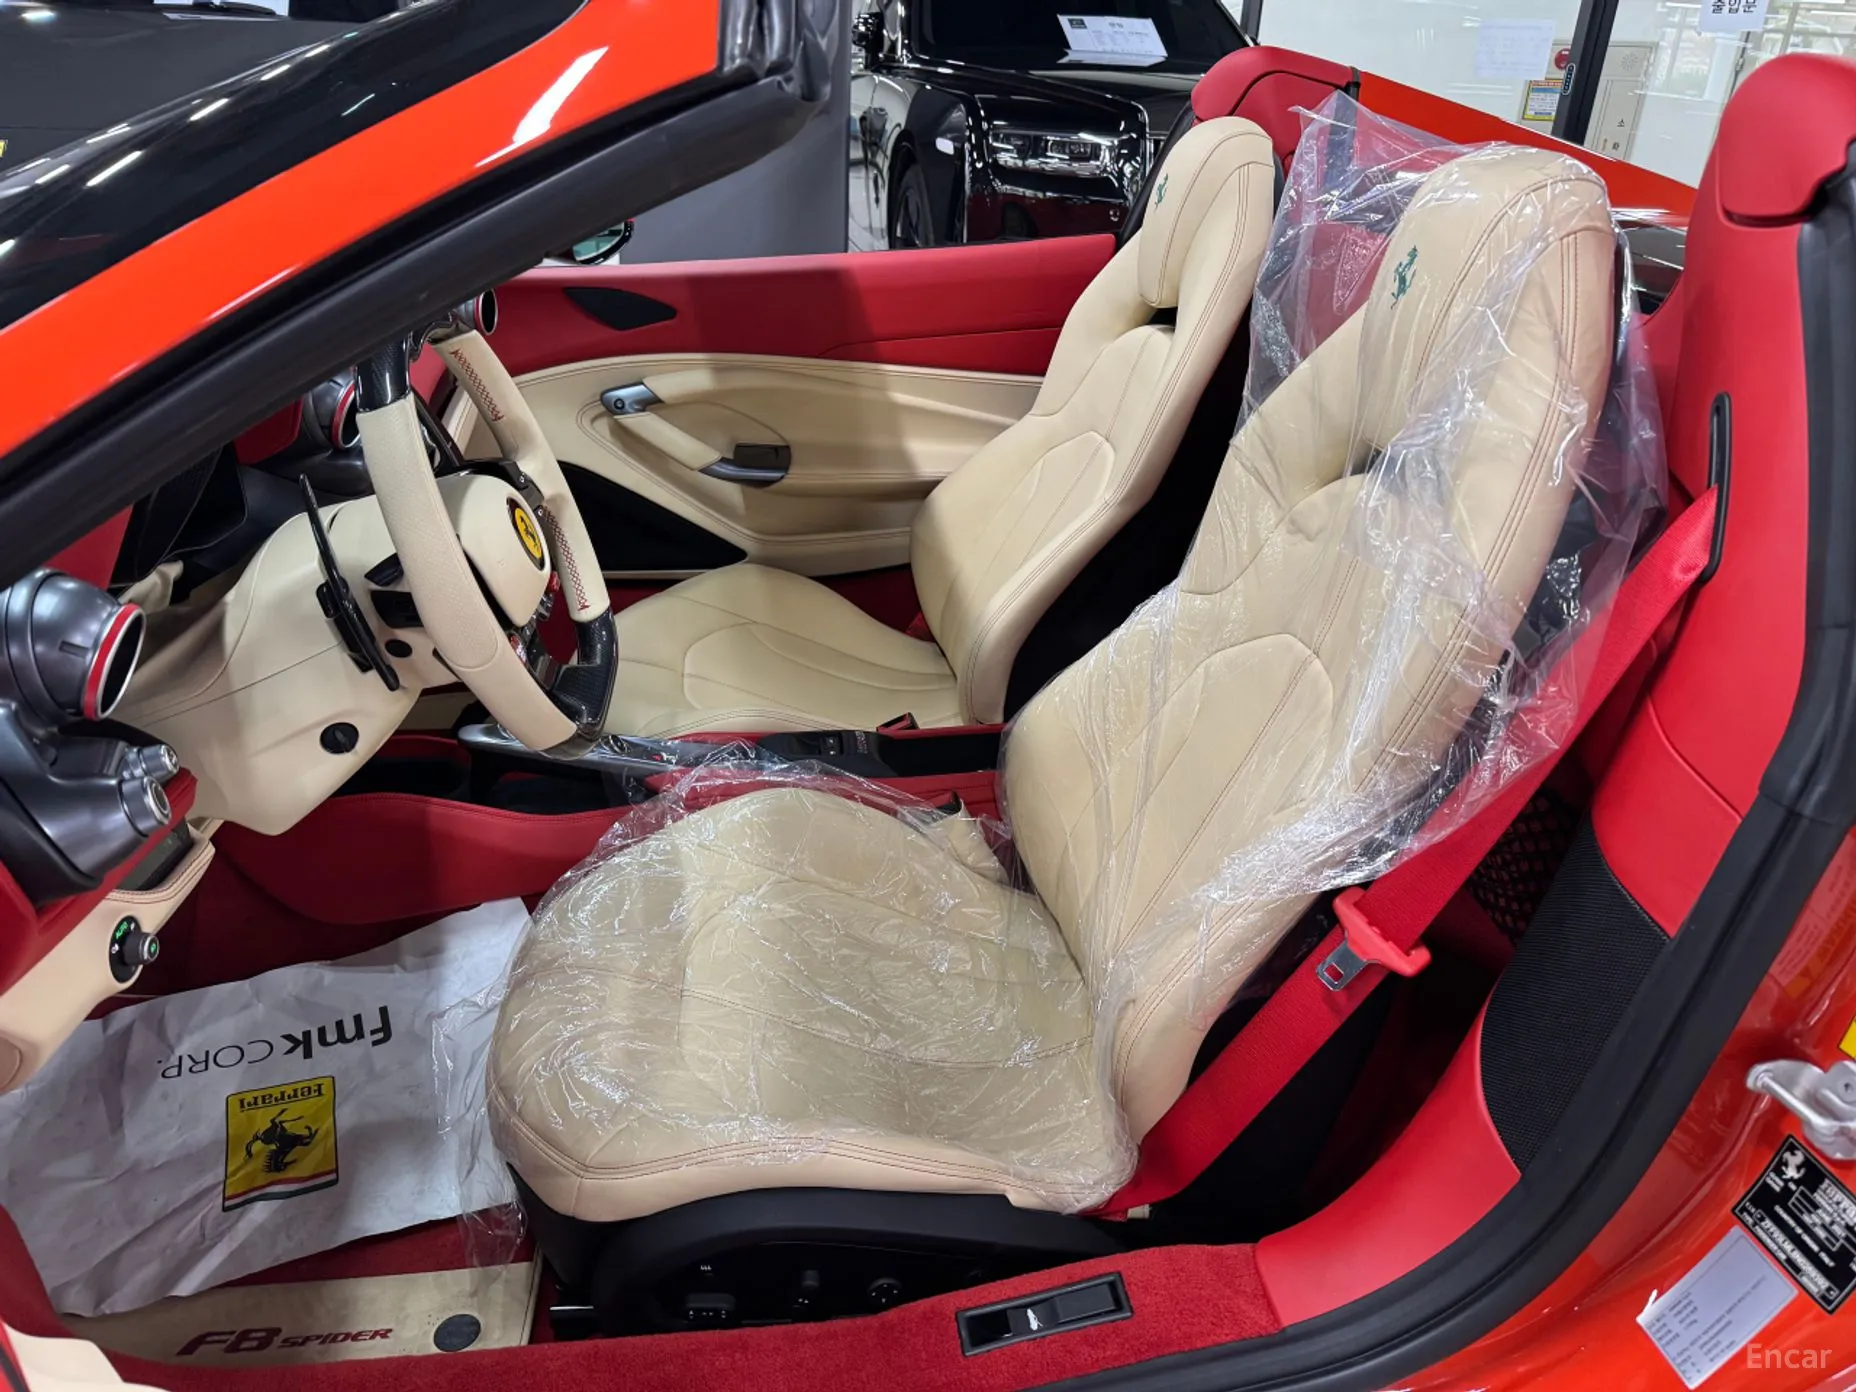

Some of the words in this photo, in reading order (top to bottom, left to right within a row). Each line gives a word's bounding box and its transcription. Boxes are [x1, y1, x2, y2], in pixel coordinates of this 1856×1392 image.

[280, 1005, 393, 1060] fmk
[156, 1039, 274, 1080] CORP.
[239, 1083, 325, 1112] Ferrari
[176, 1327, 282, 1356] F8
[279, 1328, 393, 1349] SPIDER
